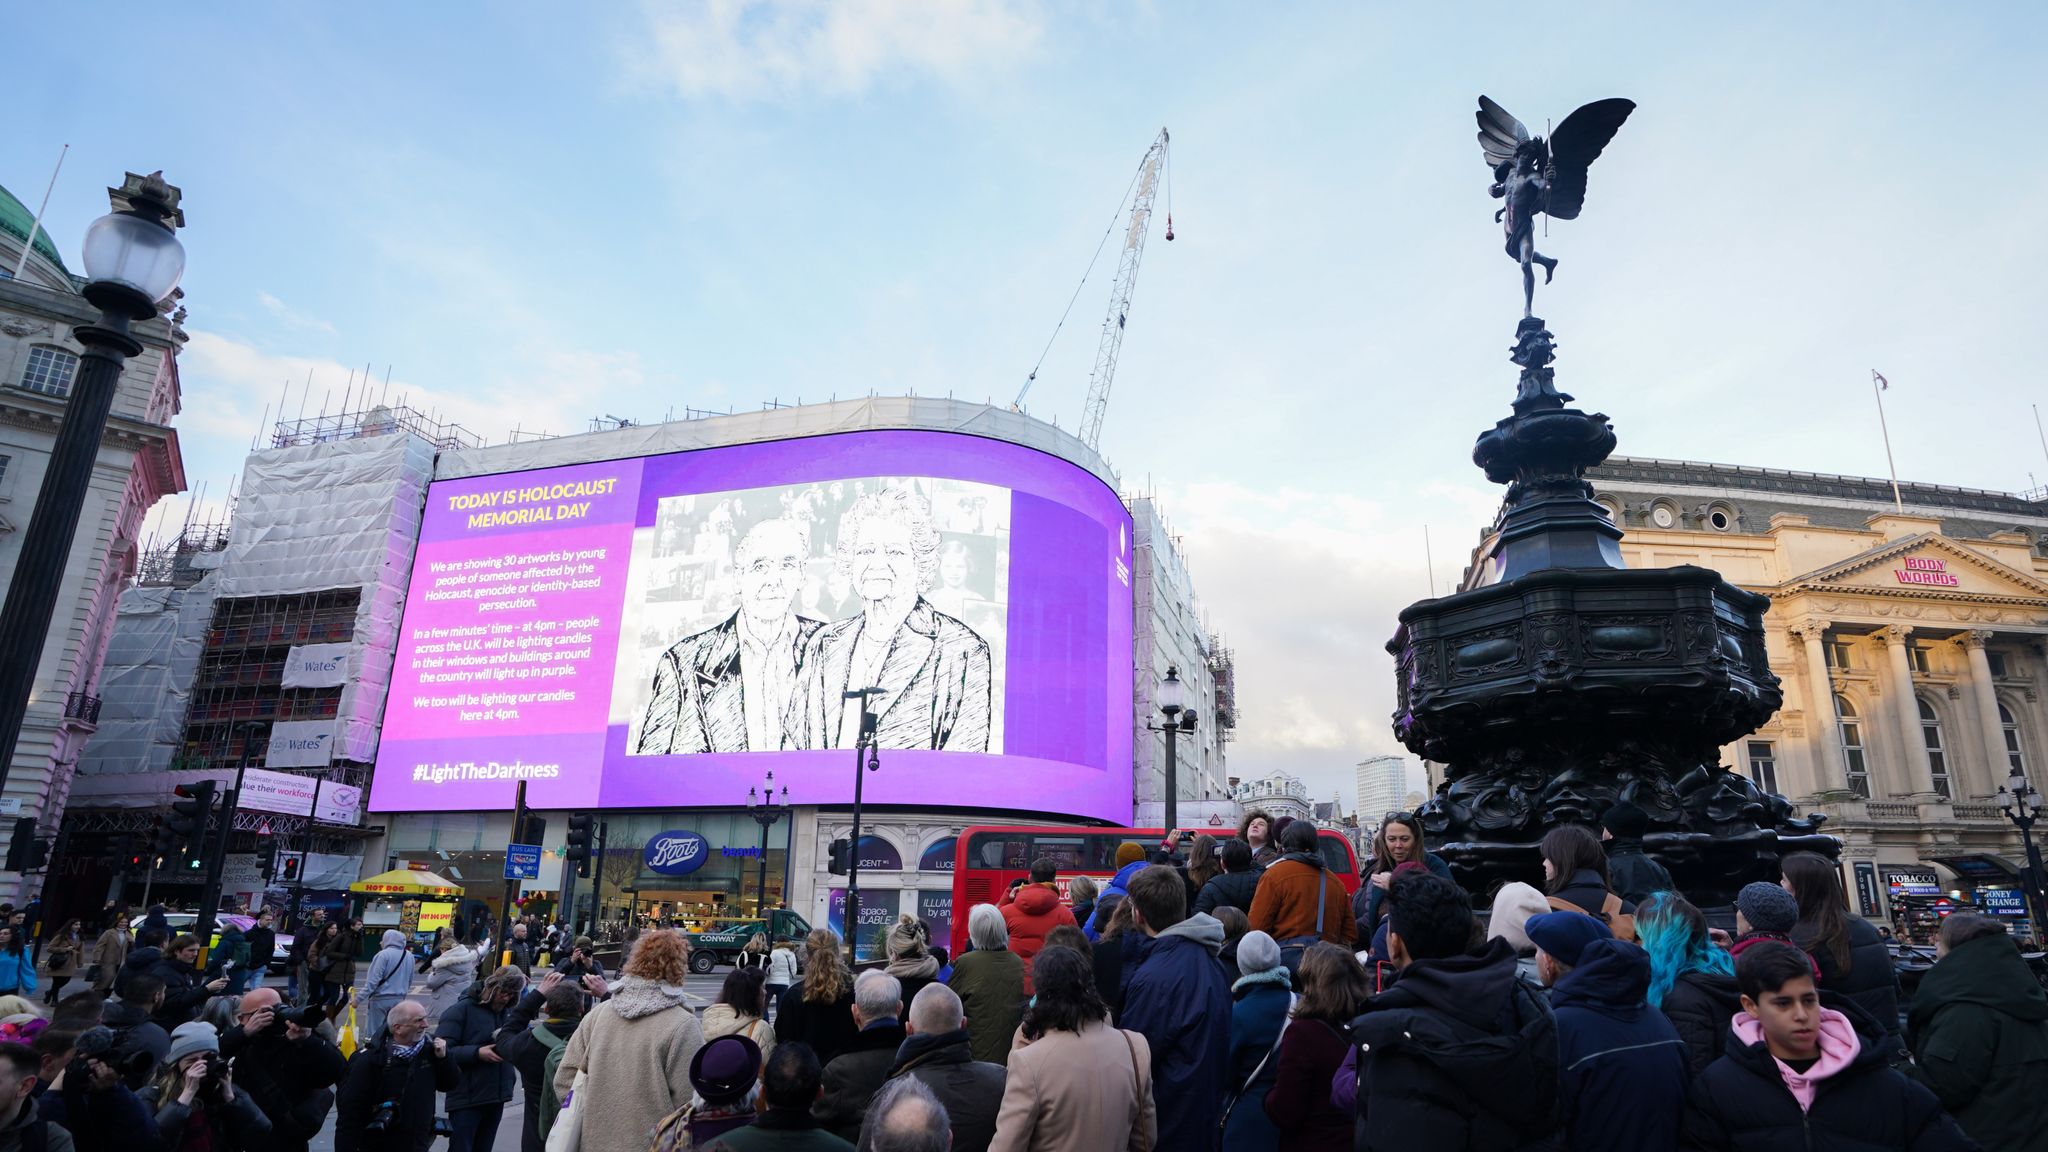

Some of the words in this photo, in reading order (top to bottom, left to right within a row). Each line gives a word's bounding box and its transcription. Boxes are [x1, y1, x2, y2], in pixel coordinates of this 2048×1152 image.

[449, 491, 502, 510] TODAY
[502, 491, 516, 505] IS
[518, 479, 616, 503] HOLOCAUST
[468, 506, 553, 529] MEMORIAL
[557, 503, 590, 519] DAY
[431, 562, 446, 572] We
[447, 562, 462, 571] are
[464, 557, 502, 571] showing
[504, 555, 516, 565] 30
[517, 551, 560, 565] artworks
[563, 550, 574, 562] by
[575, 549, 606, 560] young
[1907, 558, 1945, 570] BODY
[436, 574, 466, 588] people
[468, 572, 478, 583] of
[480, 571, 521, 582] someone
[523, 566, 562, 578] affected
[565, 565, 575, 576] by
[578, 564, 594, 573] the
[1900, 571, 1958, 586] WORLDS
[425, 588, 473, 600] Holocaust,
[474, 585, 516, 598] genocide
[519, 584, 529, 593] or
[531, 576, 600, 592] identity-based
[479, 598, 536, 612] persecution.
[414, 629, 423, 639] In
[431, 626, 449, 638] few
[491, 623, 512, 634] time
[522, 622, 532, 631] at
[534, 620, 555, 632] 4pm
[566, 617, 599, 630] people
[415, 643, 444, 654] across
[447, 641, 461, 651] the
[464, 640, 482, 650] U.K.
[484, 638, 501, 649] will
[503, 637, 515, 648] be
[517, 634, 552, 648] lighting
[554, 632, 592, 644] candles
[412, 658, 421, 668] in
[423, 656, 444, 668] their
[447, 654, 487, 667] windows
[489, 652, 507, 664] and
[509, 649, 552, 663] buildings
[554, 648, 591, 660] around
[305, 662, 336, 672] Wates
[420, 672, 435, 684] the
[436, 670, 473, 683] country
[475, 668, 491, 679] will
[494, 666, 514, 680] light
[517, 667, 529, 678] up
[531, 666, 540, 677] in
[542, 664, 576, 677] purple.
[413, 697, 430, 708] We
[432, 696, 447, 707] too
[449, 694, 465, 706] will
[467, 693, 479, 705] be
[481, 692, 517, 705] lighting
[519, 693, 535, 702] our
[538, 690, 575, 701] candles
[460, 710, 482, 721] here
[484, 710, 494, 720] at
[496, 708, 519, 721] 4pm.
[290, 740, 320, 750] Wates
[413, 762, 559, 782] #LightTheDarkness
[240, 782, 255, 790] alue
[257, 785, 275, 793] their
[278, 788, 315, 799] workforce
[273, 780, 309, 789] constructors
[649, 838, 700, 866] Boots
[722, 846, 762, 860] beauty
[1890, 874, 1936, 882] TOBACCO
[1059, 891, 1070, 900] LO
[1858, 870, 1870, 914] TOBACCO
[857, 916, 892, 924] AILABLE
[861, 908, 887, 916] space
[928, 909, 936, 918] by
